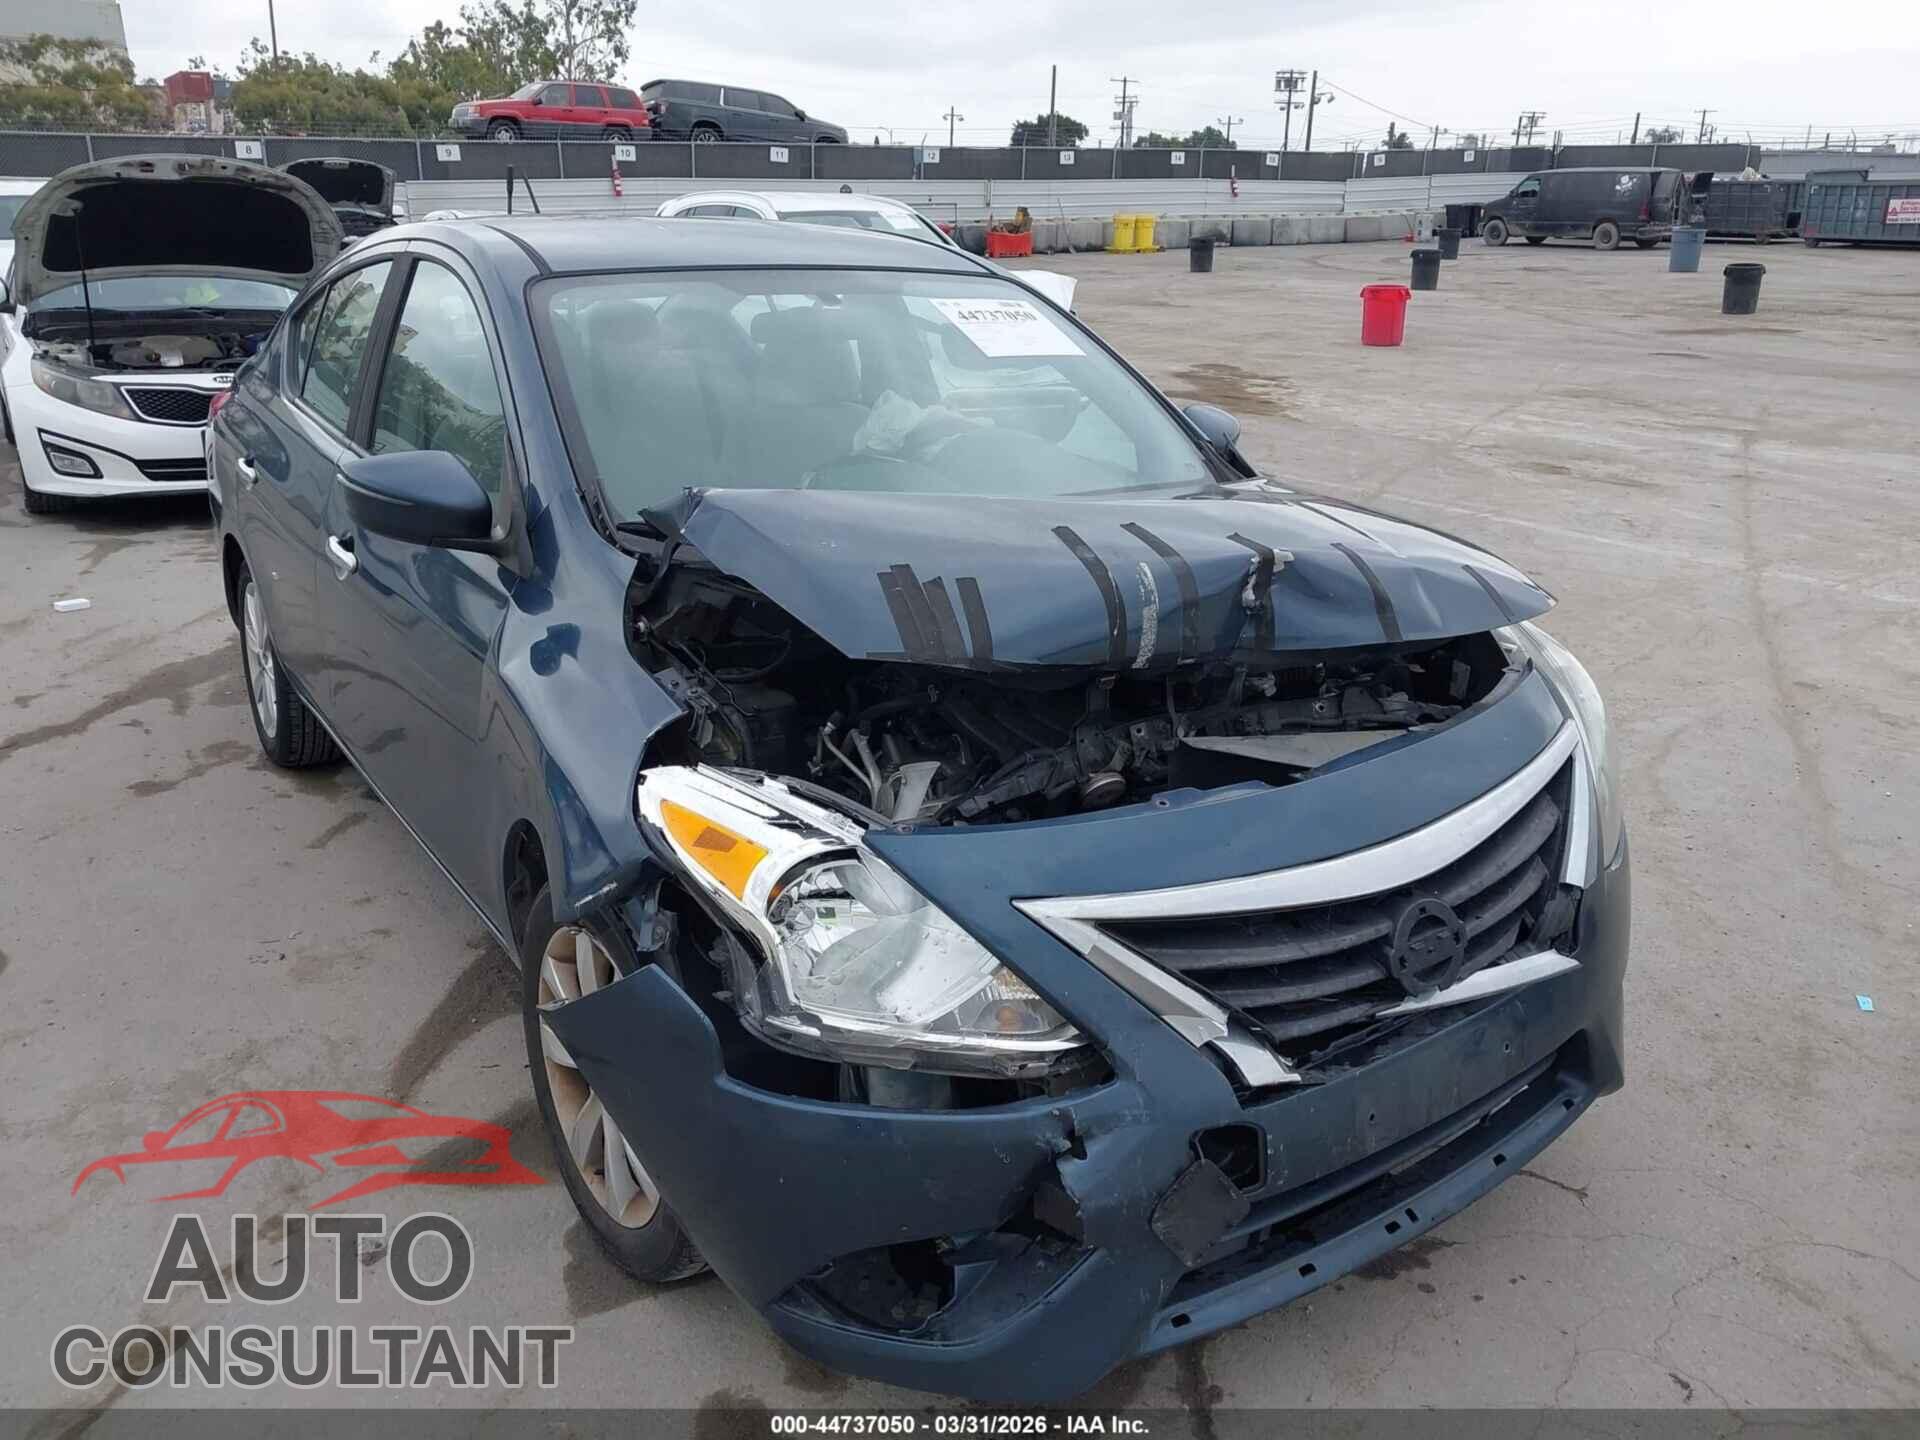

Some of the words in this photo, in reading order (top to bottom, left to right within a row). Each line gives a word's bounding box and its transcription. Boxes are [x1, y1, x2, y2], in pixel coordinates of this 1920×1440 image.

[245, 145, 252, 154] 8
[445, 148, 452, 157] 9
[621, 149, 631, 158] 10
[775, 151, 784, 160] 11
[928, 152, 936, 160] 12
[958, 310, 1038, 321] 44737050
